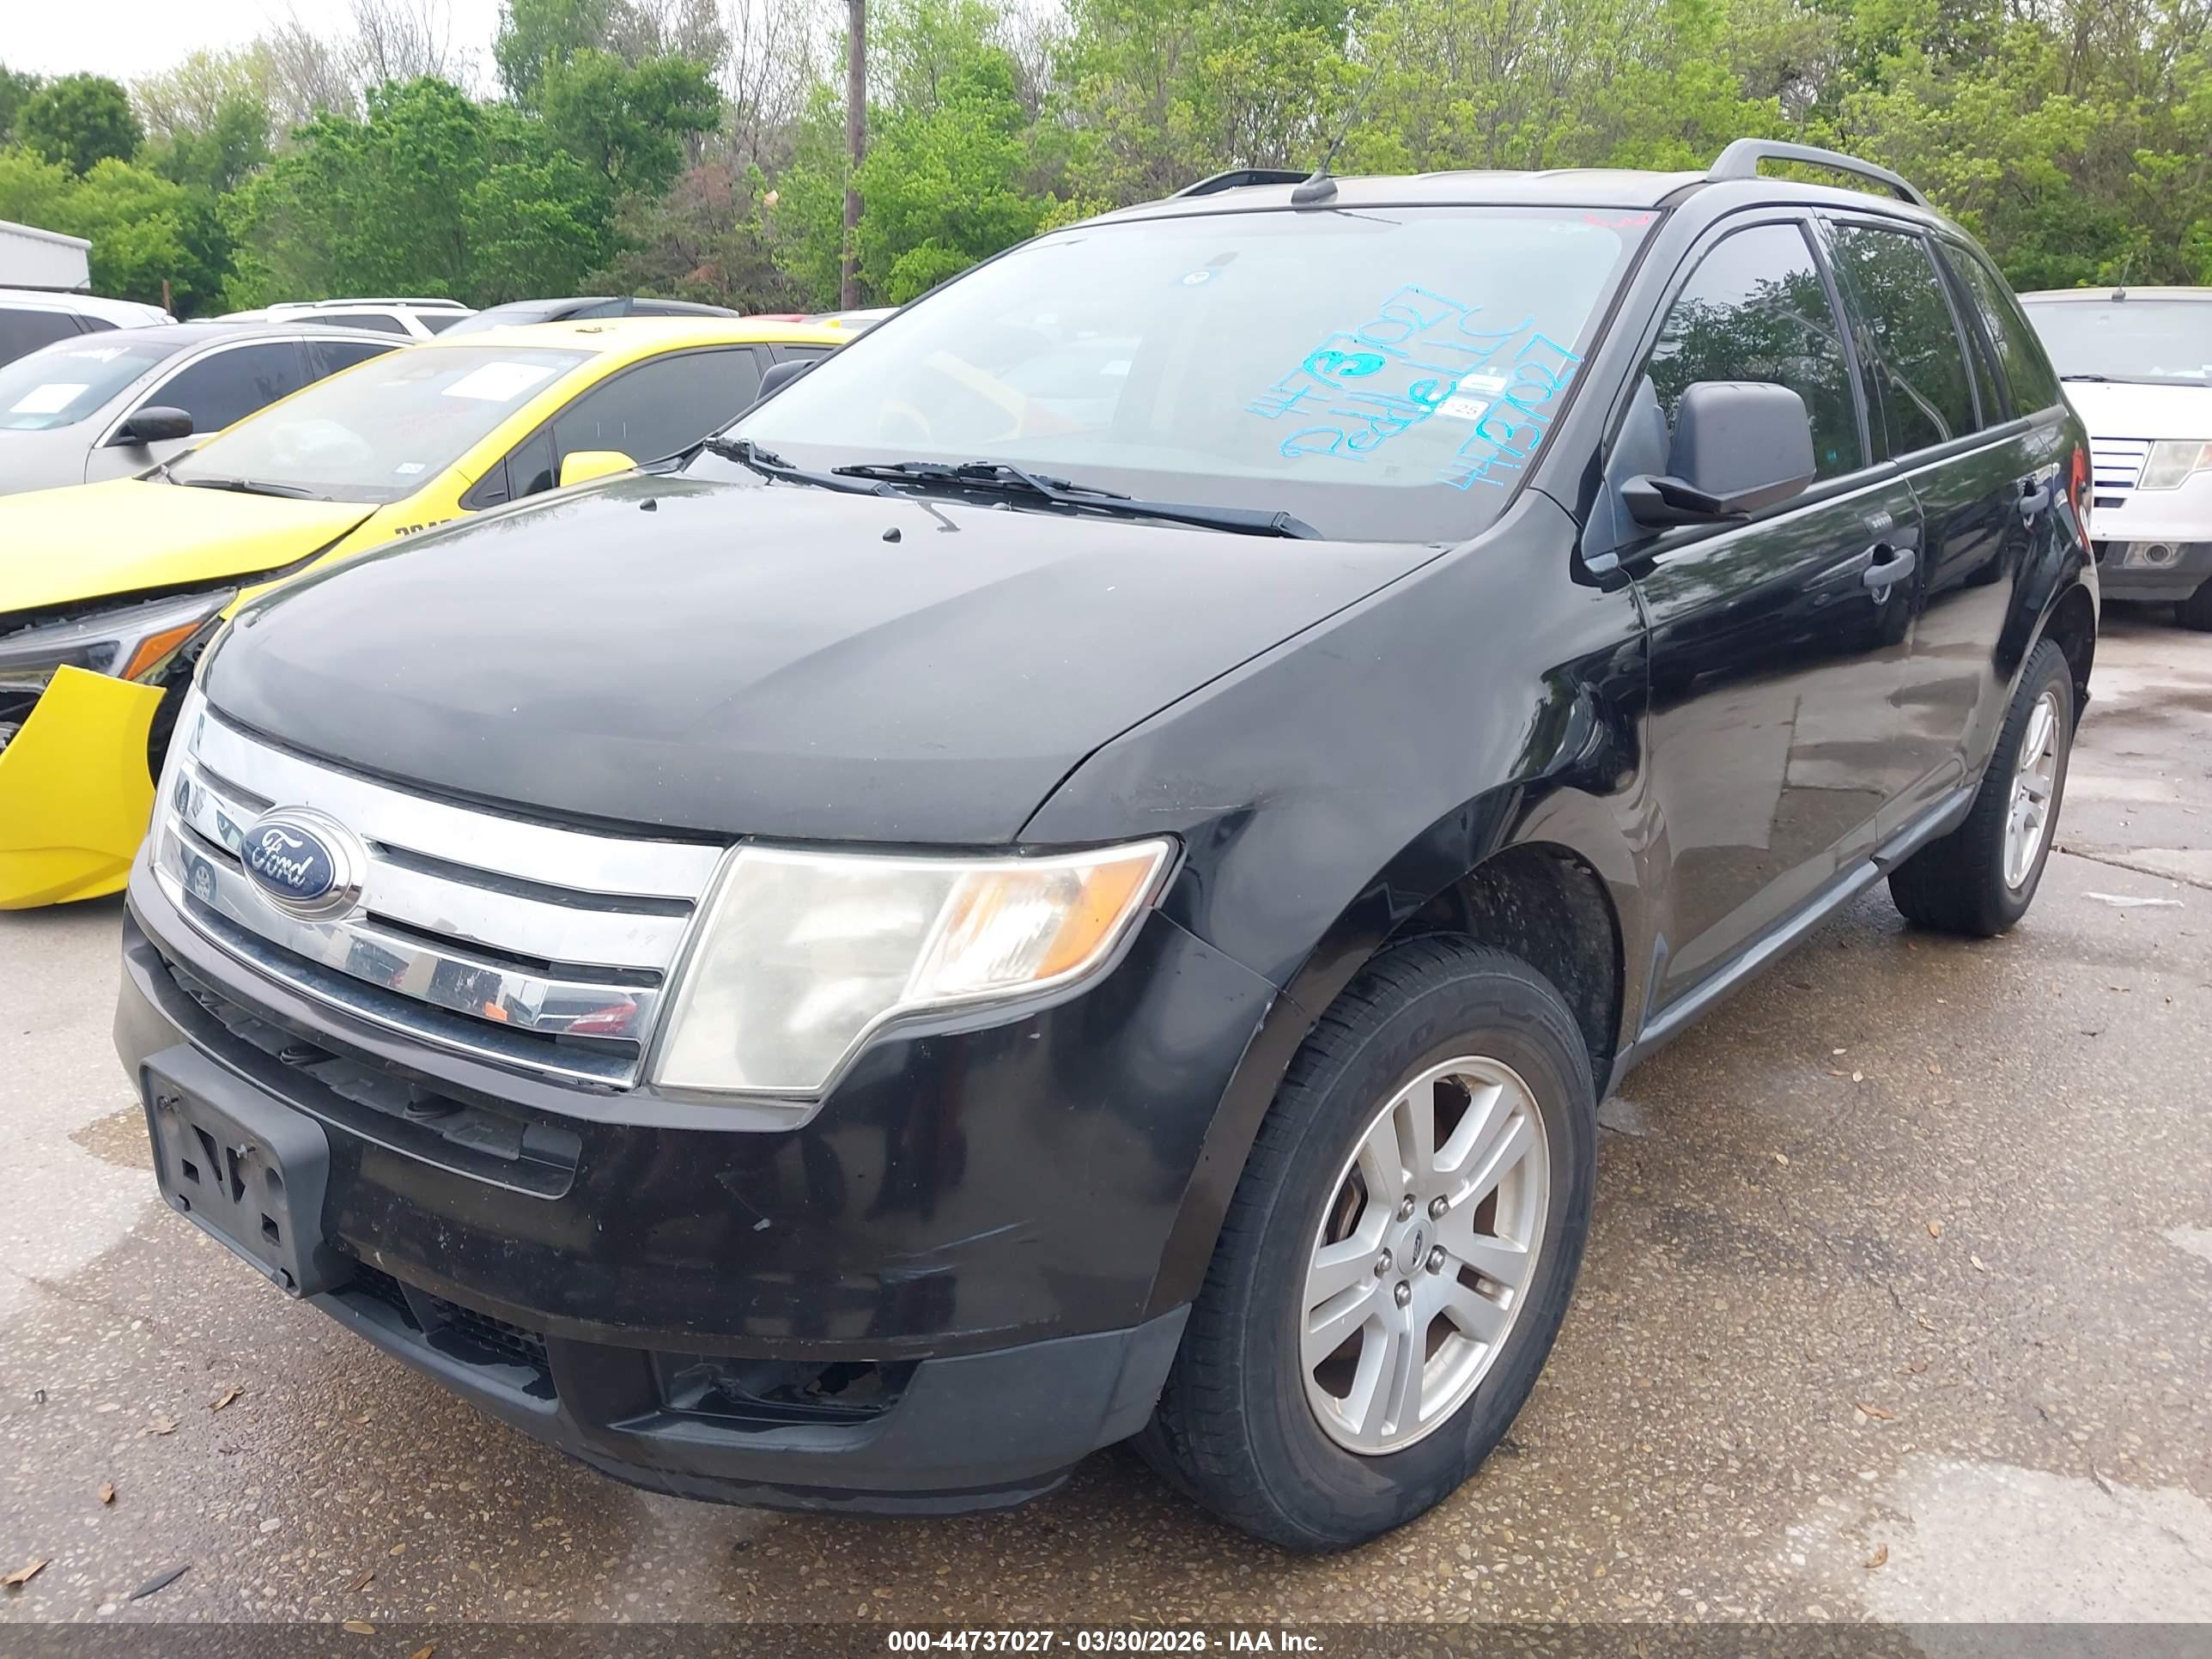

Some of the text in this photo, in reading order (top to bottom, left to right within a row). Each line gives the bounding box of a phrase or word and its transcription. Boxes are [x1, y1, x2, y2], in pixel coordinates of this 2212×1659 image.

[1400, 304, 1535, 378] LLC
[1436, 331, 1582, 490] 44737027
[252, 828, 314, 888] Ford
